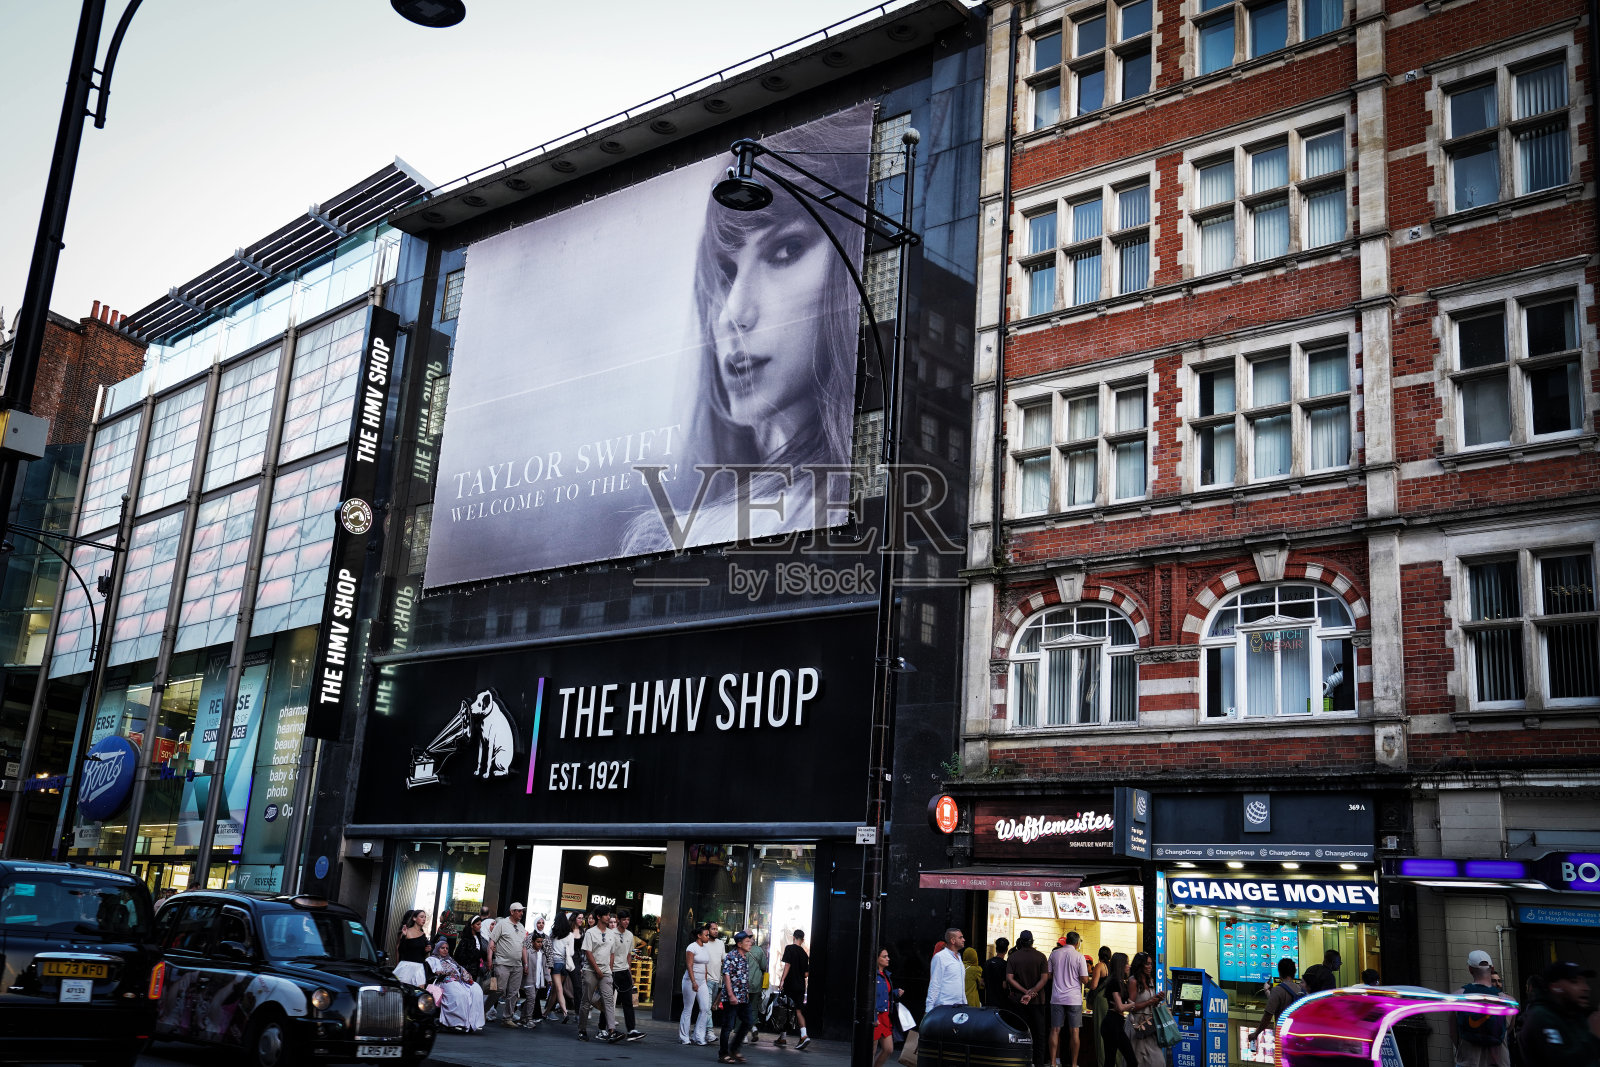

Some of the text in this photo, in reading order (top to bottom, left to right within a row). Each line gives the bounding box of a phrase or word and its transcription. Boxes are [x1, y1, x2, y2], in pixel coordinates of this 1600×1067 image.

[357, 337, 390, 463] THE HMV SHOP
[454, 424, 681, 499] TAYLOR SWIFT
[451, 488, 546, 523] WELCOME
[553, 483, 579, 503] TO
[588, 472, 631, 496] THE
[320, 568, 357, 704] THE HMV SHOP
[1264, 630, 1303, 641] WATCH
[1264, 640, 1303, 652] REPAIR
[560, 668, 819, 739] THE HMV SHOP
[279, 705, 308, 720] pharma
[274, 738, 299, 751] beauty
[272, 754, 289, 765] food
[290, 754, 296, 764] &
[269, 769, 287, 783] baby
[288, 770, 294, 780] &
[549, 761, 630, 791] EST. 1921
[266, 786, 288, 800] photo
[995, 811, 1114, 844] Wafflemeister
[1325, 850, 1369, 858] ChangeGroup
[1172, 881, 1379, 905] CHANGE MONEY
[1157, 877, 1166, 948] MONEY
[1545, 915, 1579, 923] Marylebone
[48, 963, 79, 975] LL73
[1208, 998, 1228, 1013] ATM
[1178, 1054, 1196, 1062] FREE
[1209, 1053, 1226, 1064] FREE
